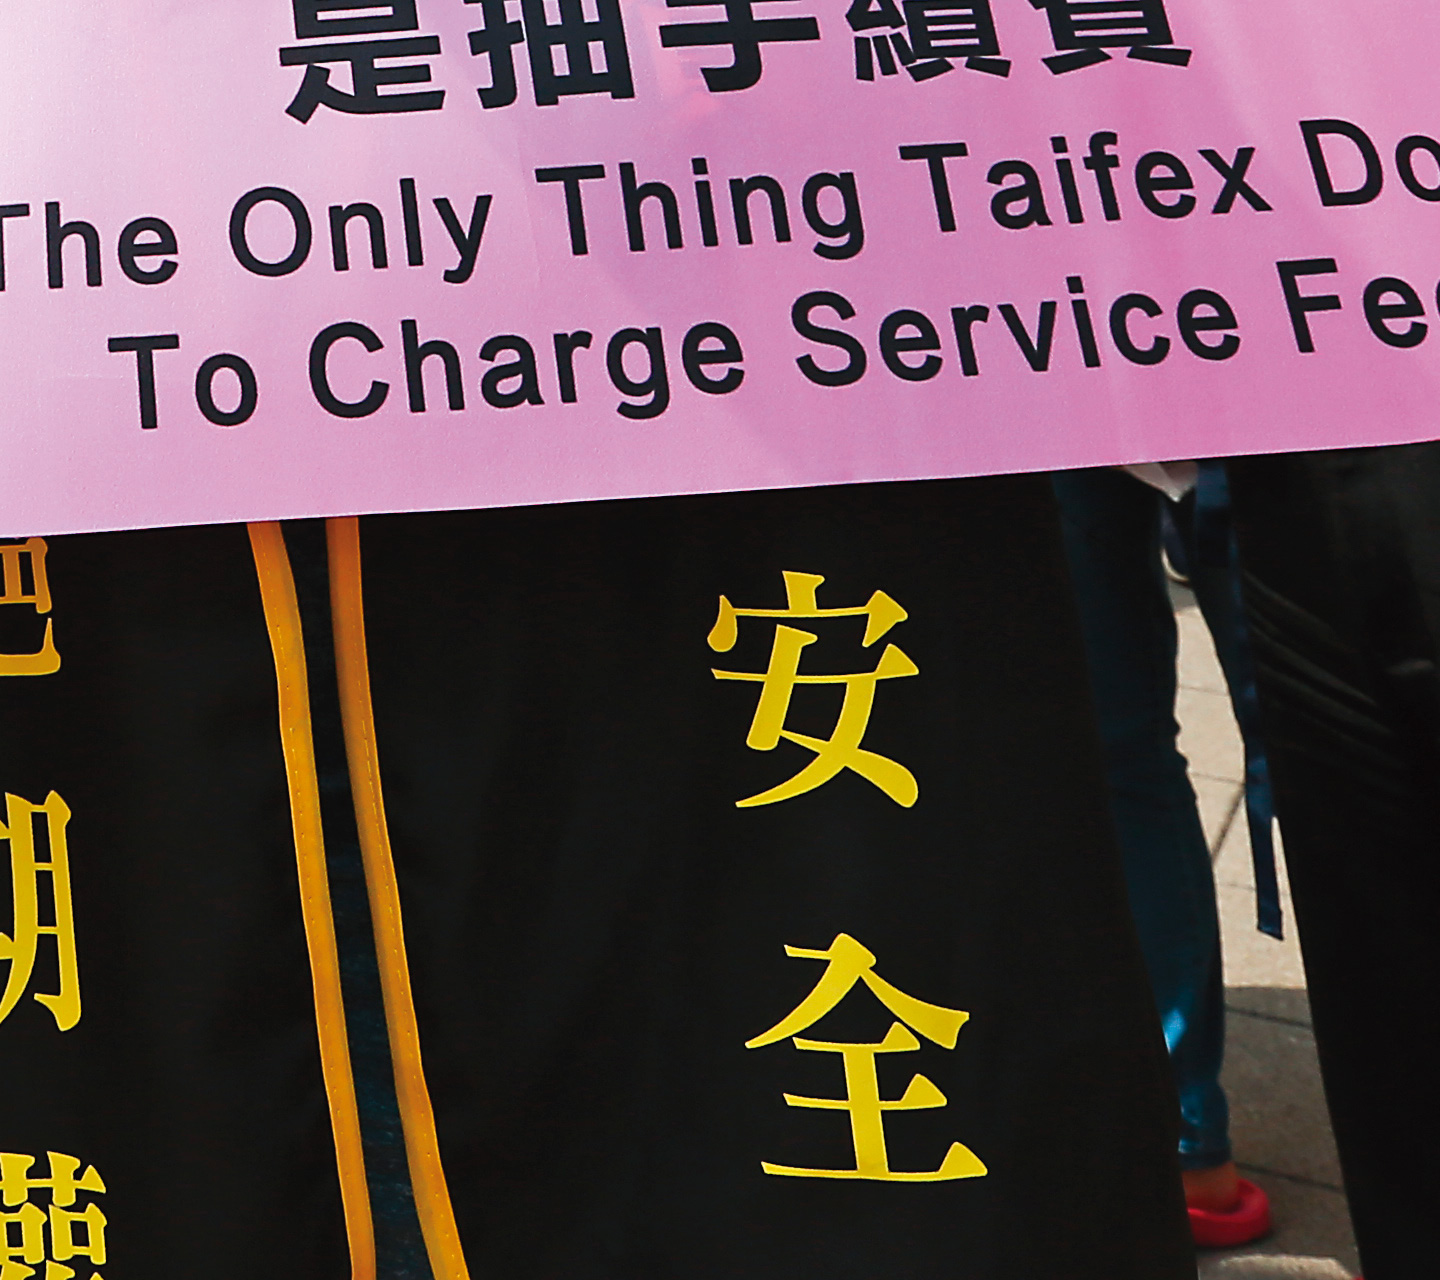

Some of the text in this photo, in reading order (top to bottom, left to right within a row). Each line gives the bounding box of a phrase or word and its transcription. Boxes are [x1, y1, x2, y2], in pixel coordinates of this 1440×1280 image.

[229, 177, 493, 285] Only
[536, 156, 865, 261] Thing
[900, 131, 1272, 234] Taifex
[108, 334, 258, 431] To
[308, 316, 746, 421] Charge
[791, 274, 1242, 388] Service
[707, 570, 988, 1182] 安全
